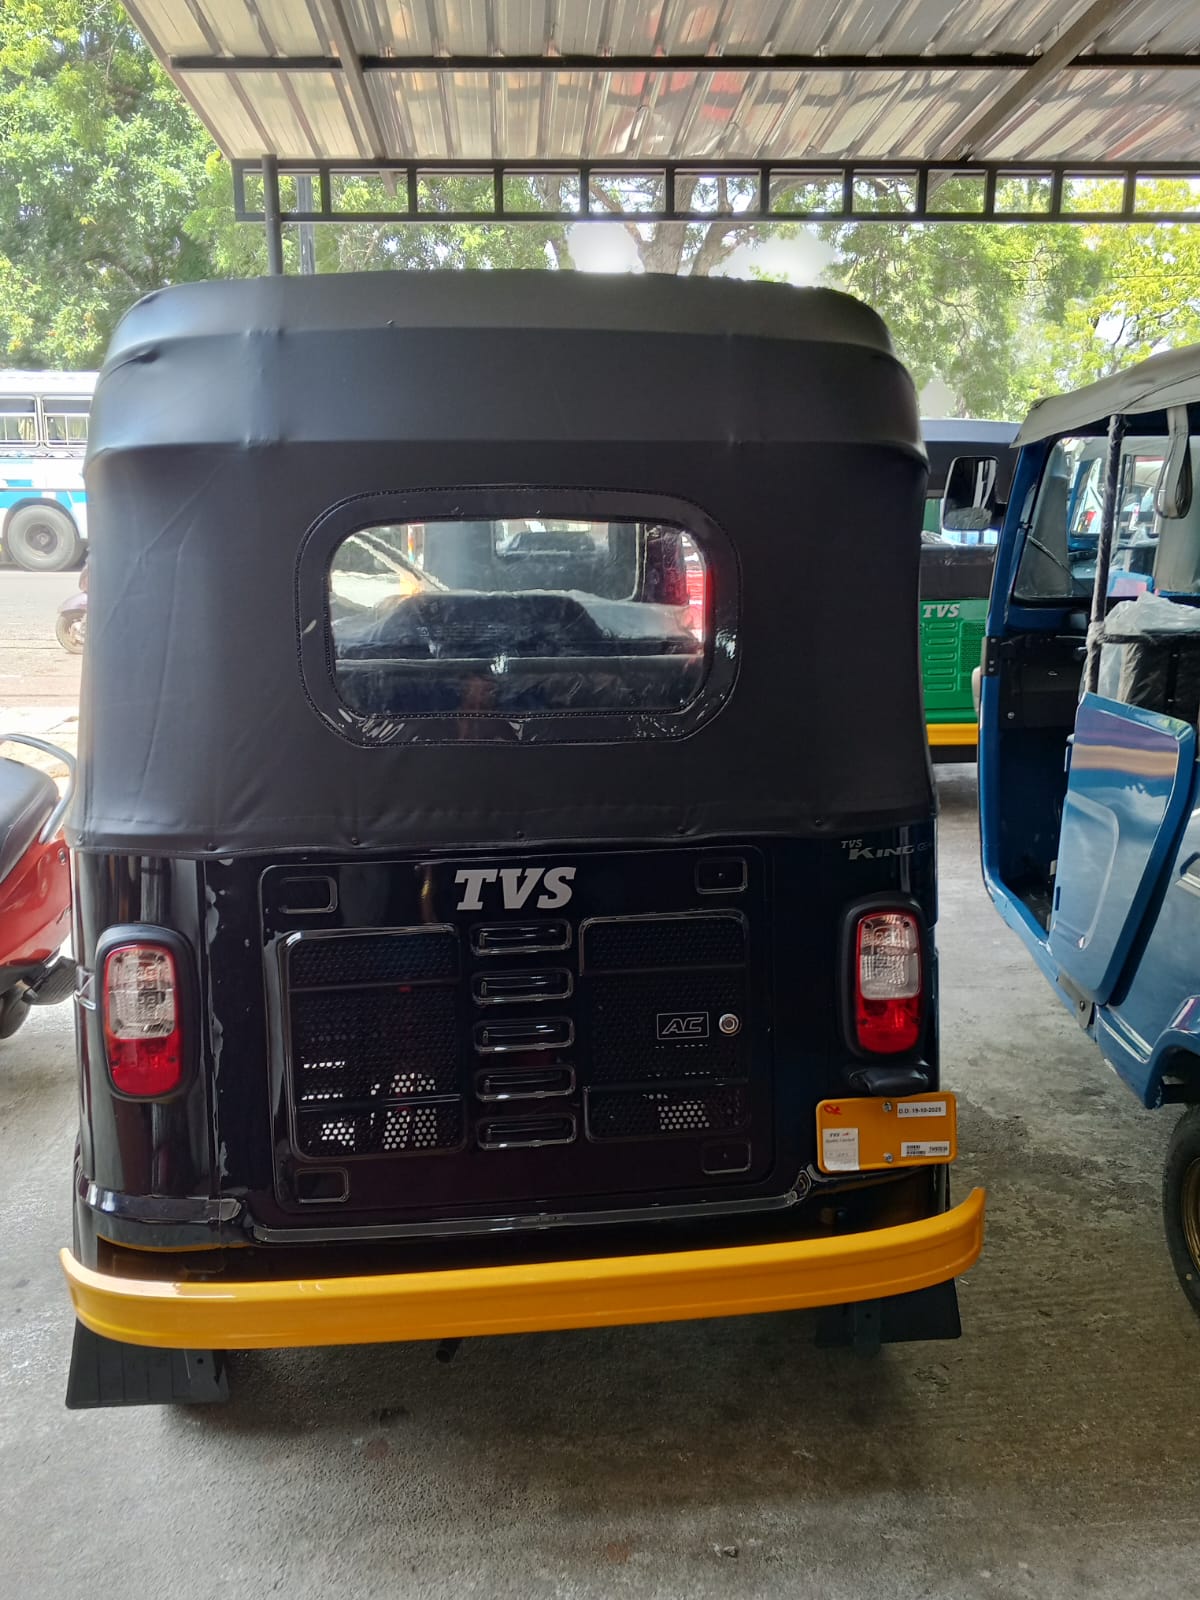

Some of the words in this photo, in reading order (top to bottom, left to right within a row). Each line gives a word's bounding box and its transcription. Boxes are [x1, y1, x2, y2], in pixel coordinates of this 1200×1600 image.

[923, 603, 961, 618] TVS
[841, 839, 863, 849] TVS
[848, 844, 915, 860] KING
[454, 866, 577, 911] TVS
[661, 1016, 705, 1035] AC
